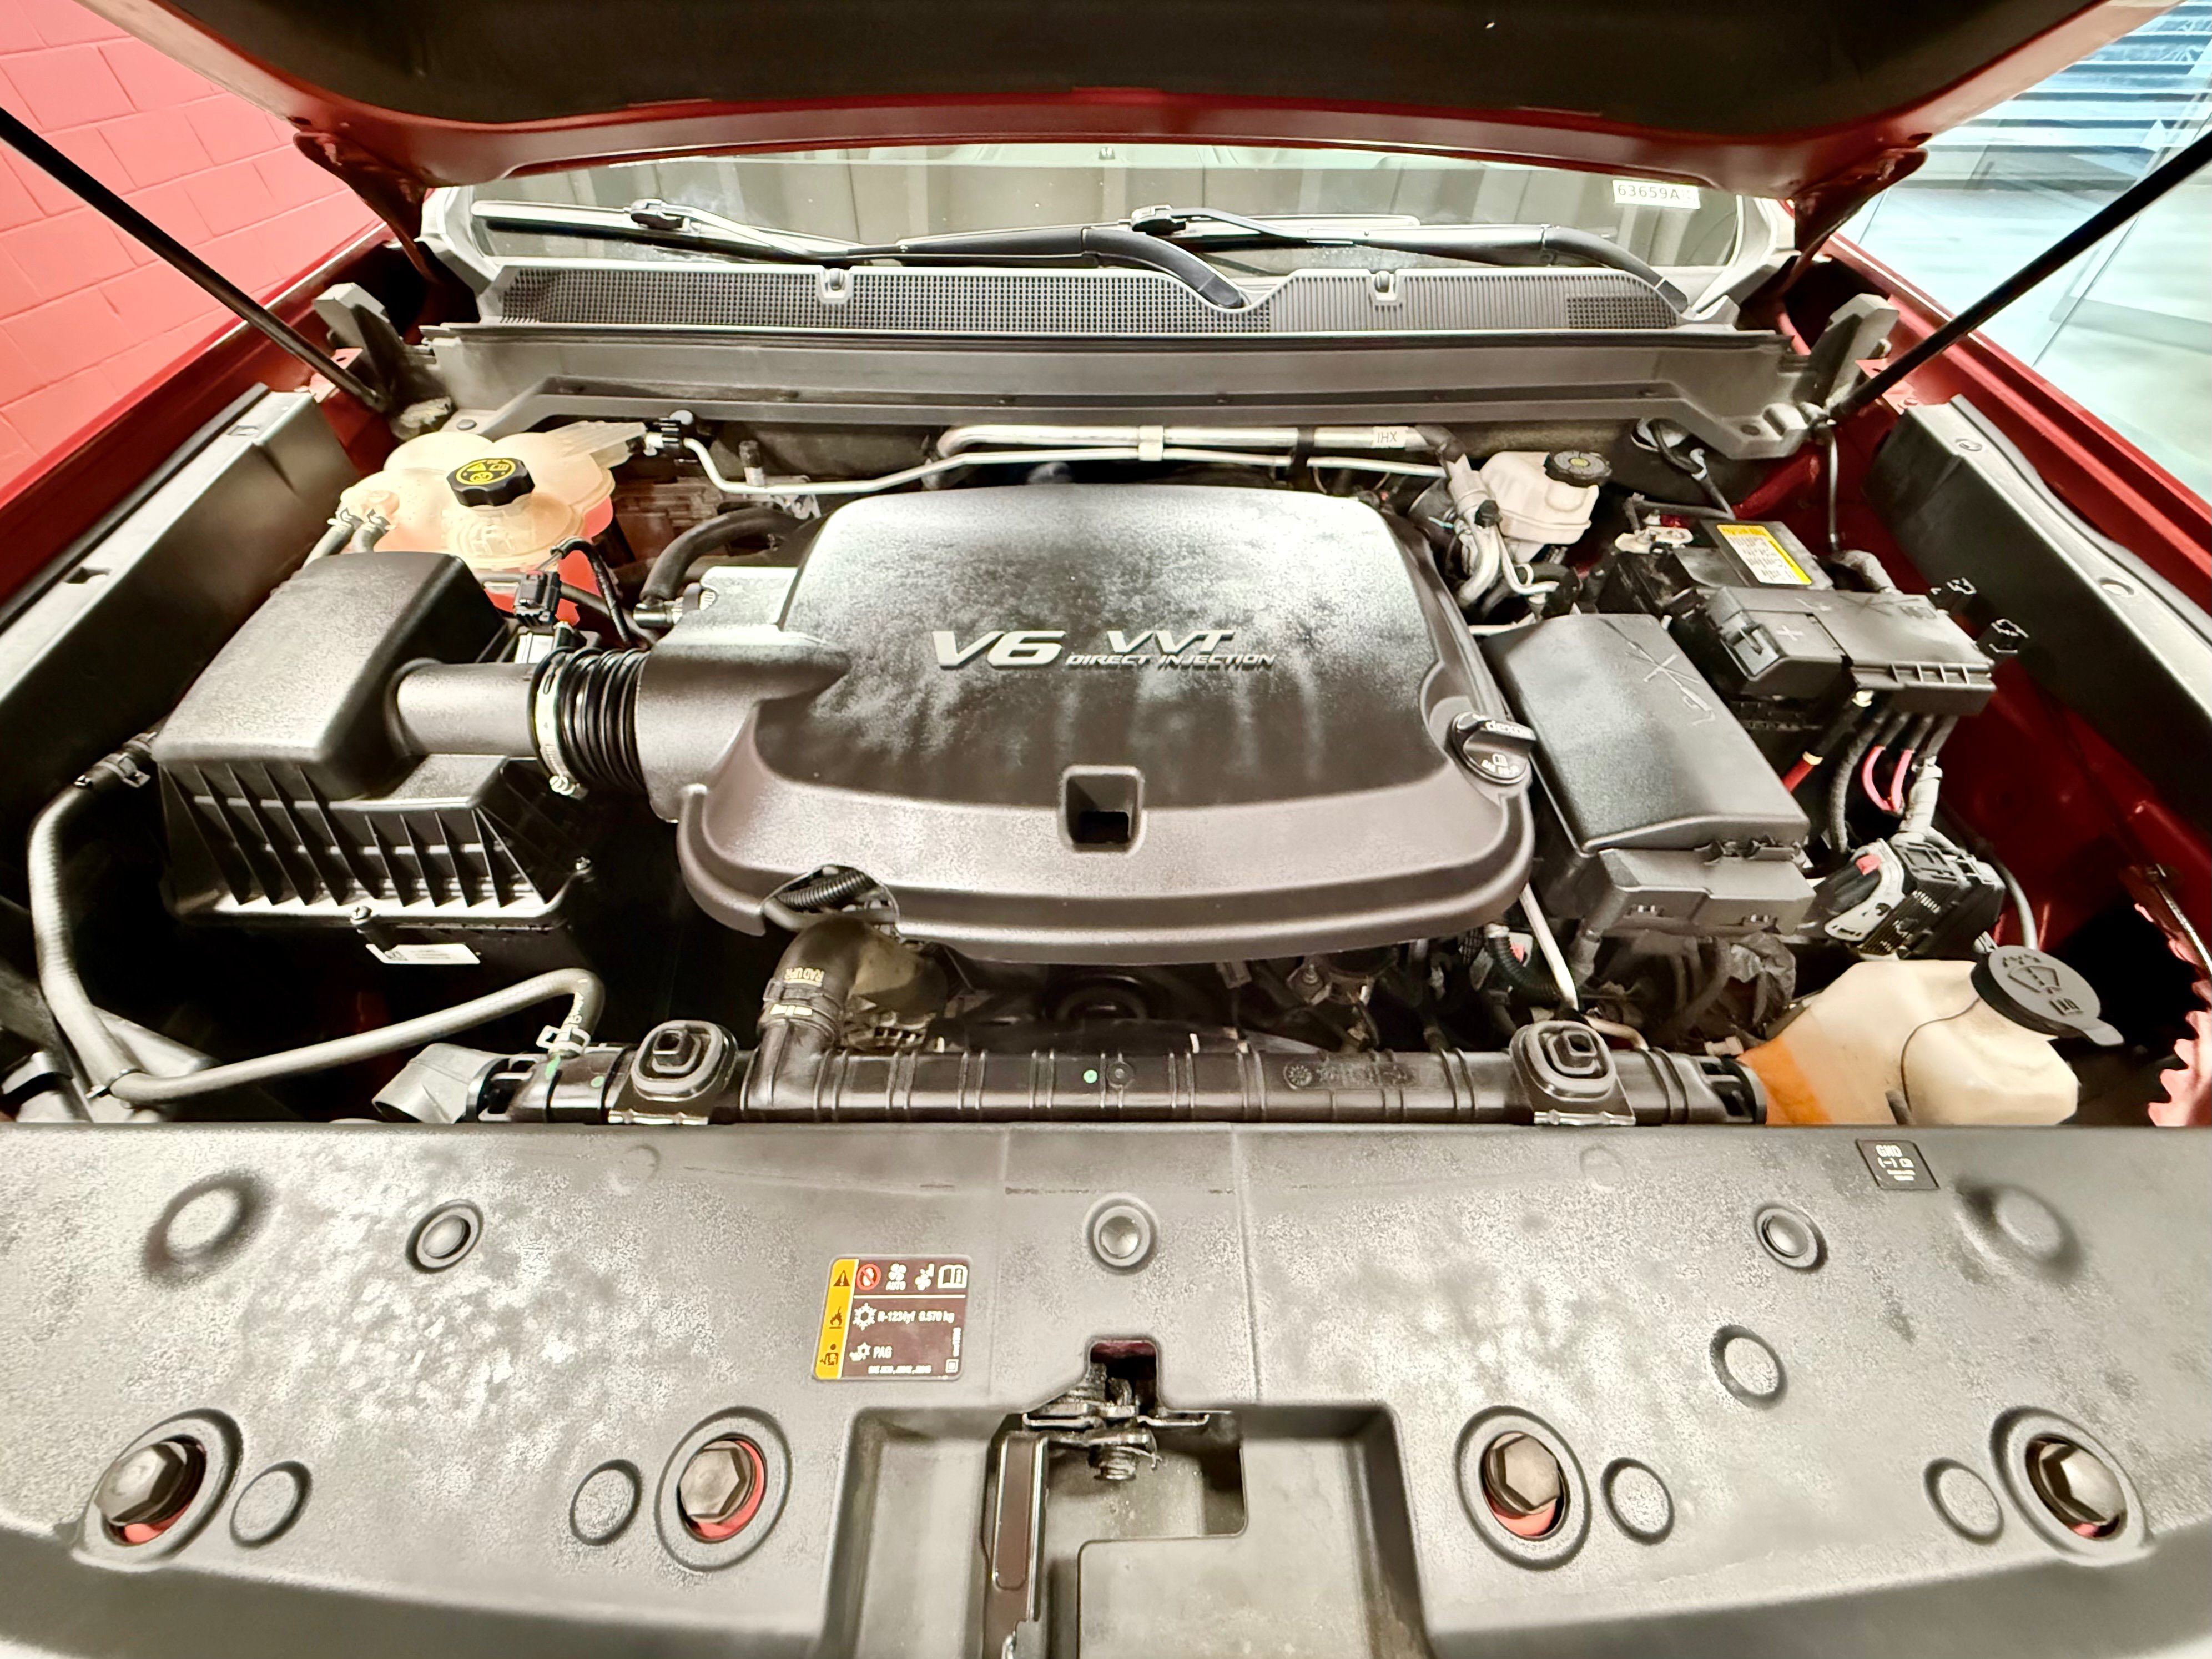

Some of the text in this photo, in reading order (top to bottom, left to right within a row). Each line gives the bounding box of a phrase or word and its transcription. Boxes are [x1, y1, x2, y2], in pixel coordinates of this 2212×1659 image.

[1618, 184, 1680, 200] 63659A
[931, 630, 1236, 669] V6 VVT
[1065, 653, 1276, 669] DIRECT INJECTION
[1875, 1144, 1903, 1158] GND
[873, 1345, 893, 1359] PAG
